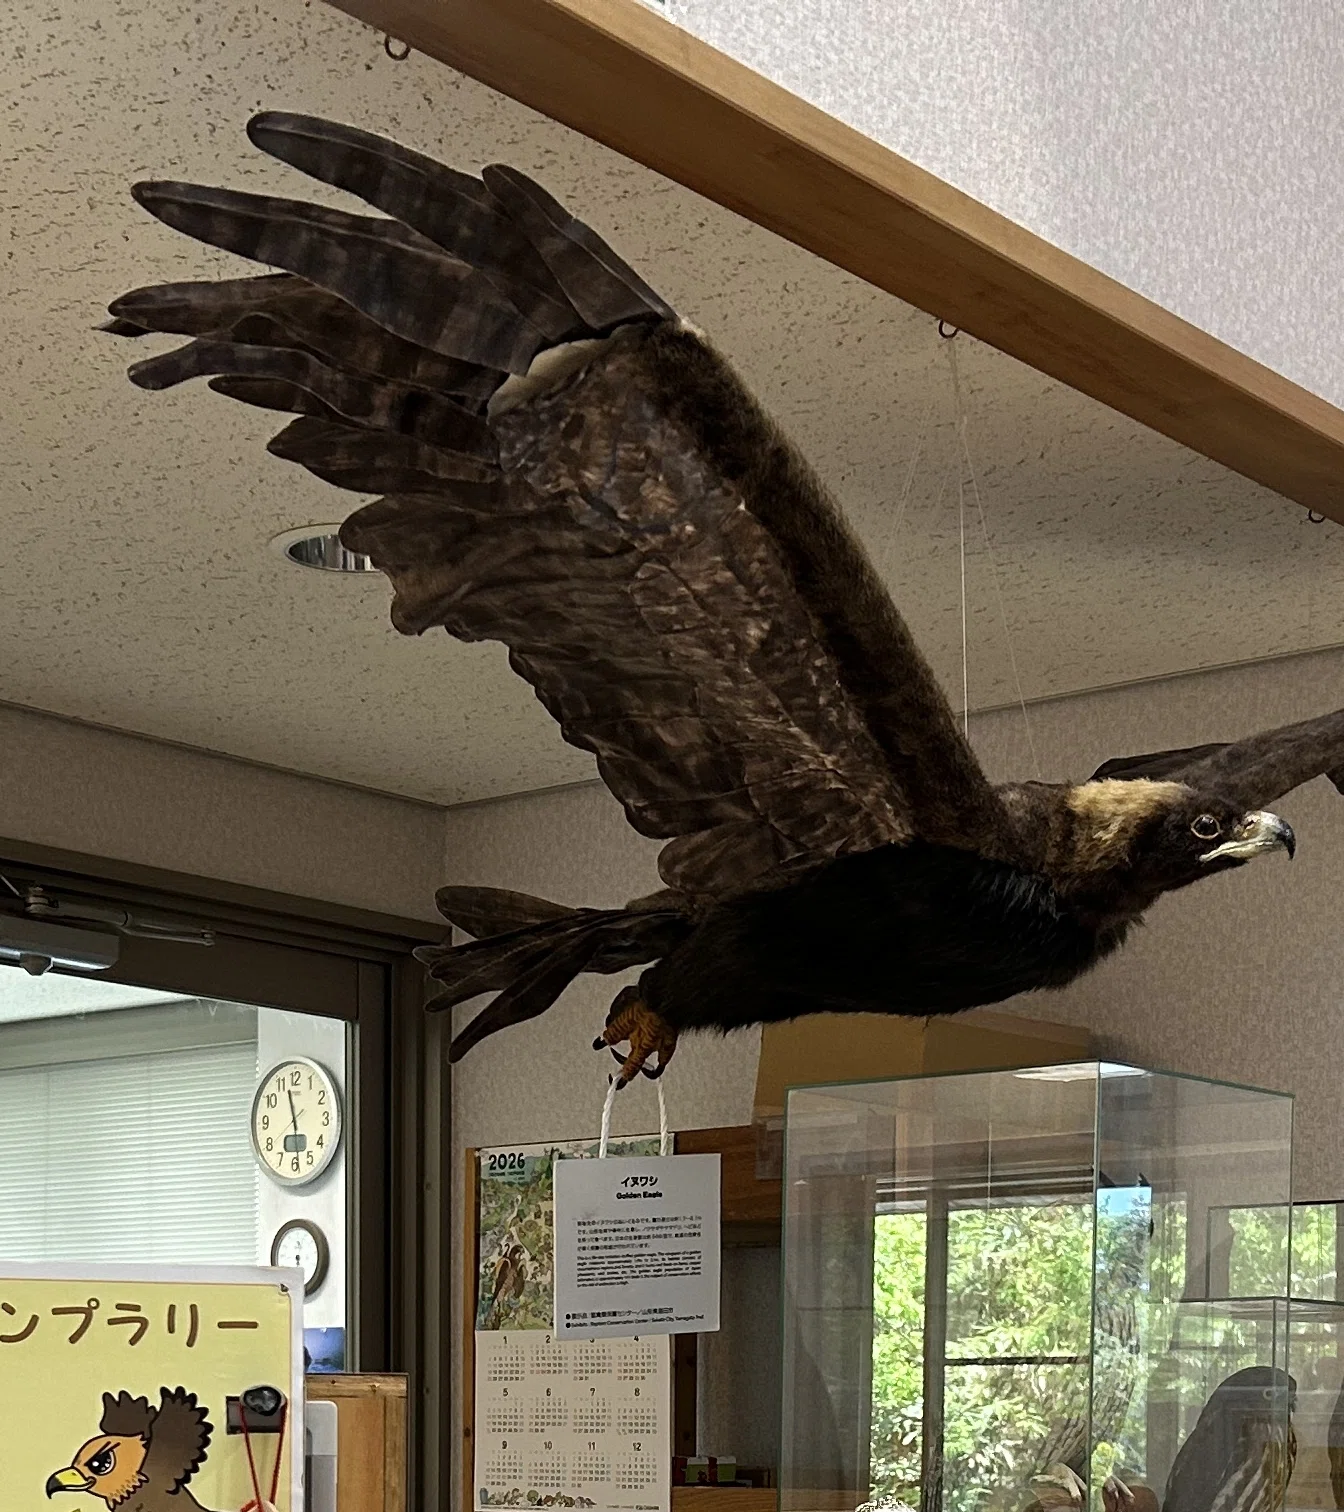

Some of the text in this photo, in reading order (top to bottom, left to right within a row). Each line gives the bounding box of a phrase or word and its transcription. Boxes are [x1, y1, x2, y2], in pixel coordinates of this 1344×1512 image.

[276, 1077, 286, 1093] 11
[290, 1071, 302, 1086] 12
[307, 1075, 313, 1091] 1
[266, 1093, 277, 1108] 10
[318, 1090, 326, 1105] 2
[262, 1115, 269, 1130] 9
[322, 1111, 330, 1126] 3
[266, 1137, 273, 1151] 8
[316, 1134, 324, 1148] 4
[277, 1152, 284, 1167] 7
[291, 1157, 299, 1171] 6
[306, 1151, 314, 1165] 5
[488, 1153, 525, 1171] 2026
[621, 1176, 658, 1188] イヌワシ
[616, 1191, 663, 1200] Golden Eagle
